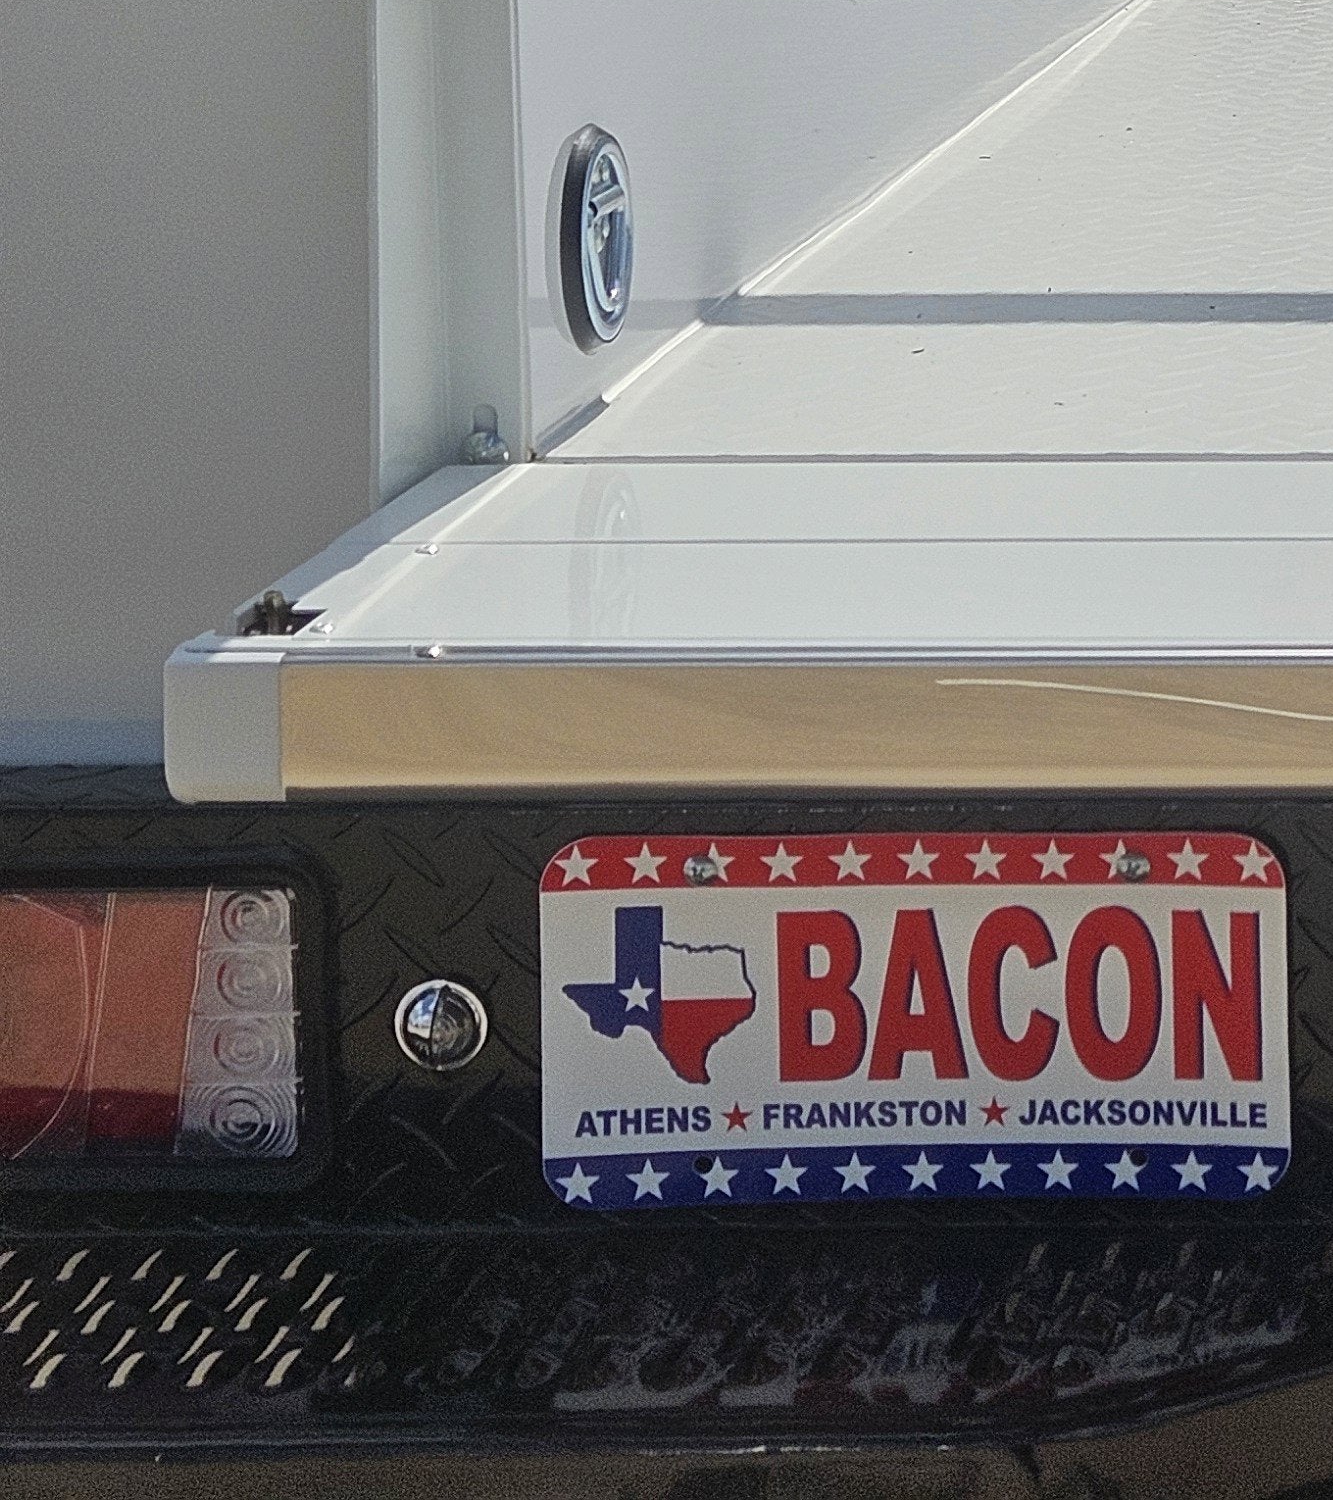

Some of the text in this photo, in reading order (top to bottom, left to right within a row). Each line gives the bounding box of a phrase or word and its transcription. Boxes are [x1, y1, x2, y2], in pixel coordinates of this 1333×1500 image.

[775, 904, 1264, 1084] BACON
[574, 1097, 1269, 1138] ATHENS FRANKSTON JACKSONVILLE
